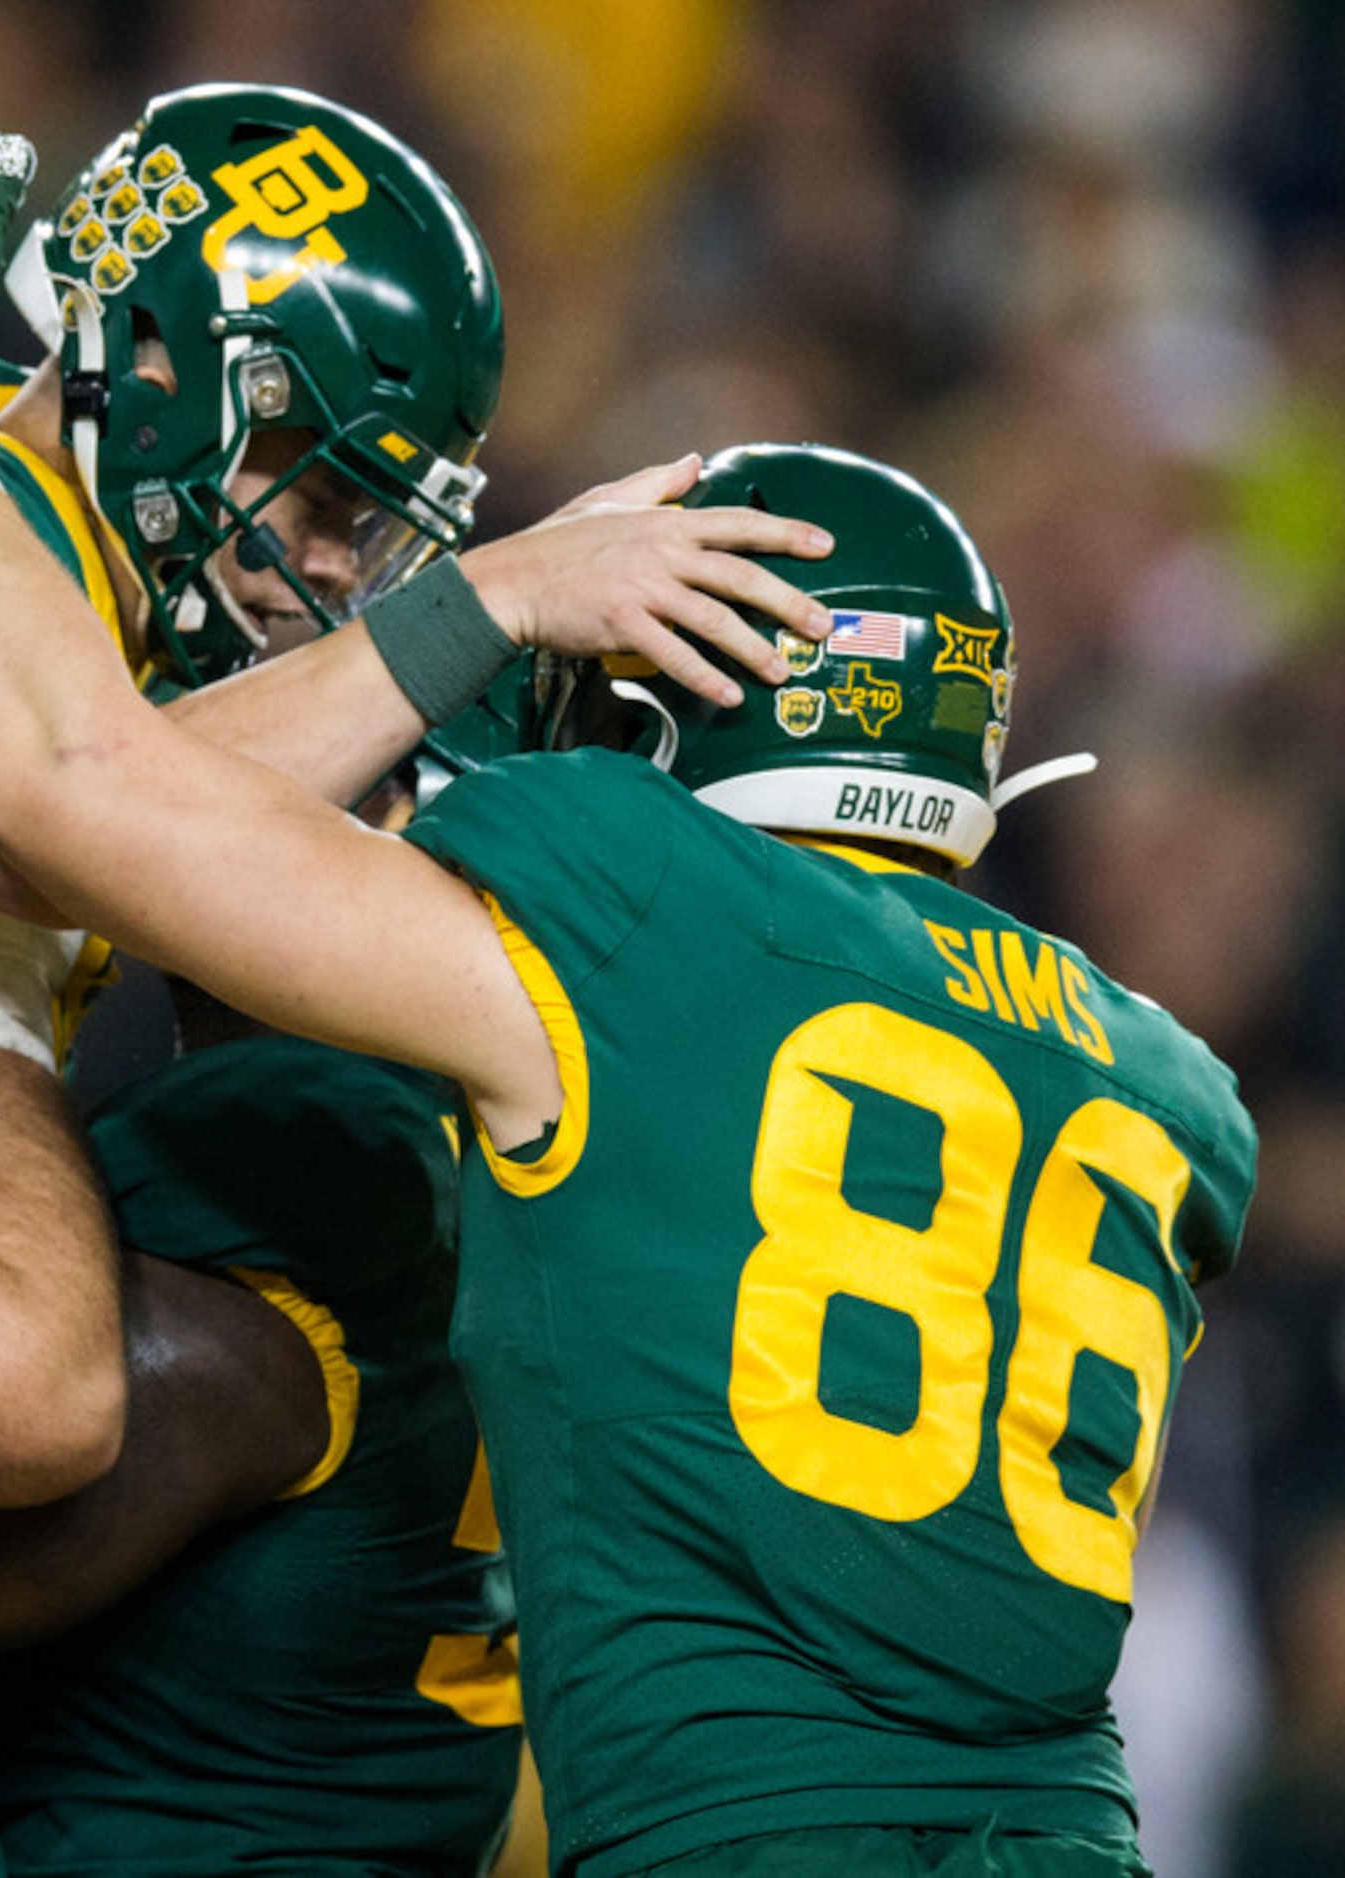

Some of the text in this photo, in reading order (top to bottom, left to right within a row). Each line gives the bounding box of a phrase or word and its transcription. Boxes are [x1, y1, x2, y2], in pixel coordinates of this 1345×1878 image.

[936, 616, 998, 680] XII
[852, 687, 896, 710] 210
[835, 783, 955, 836] BAYLOR
[922, 918, 1116, 1067] SIMS
[727, 1001, 1192, 1604] 86
